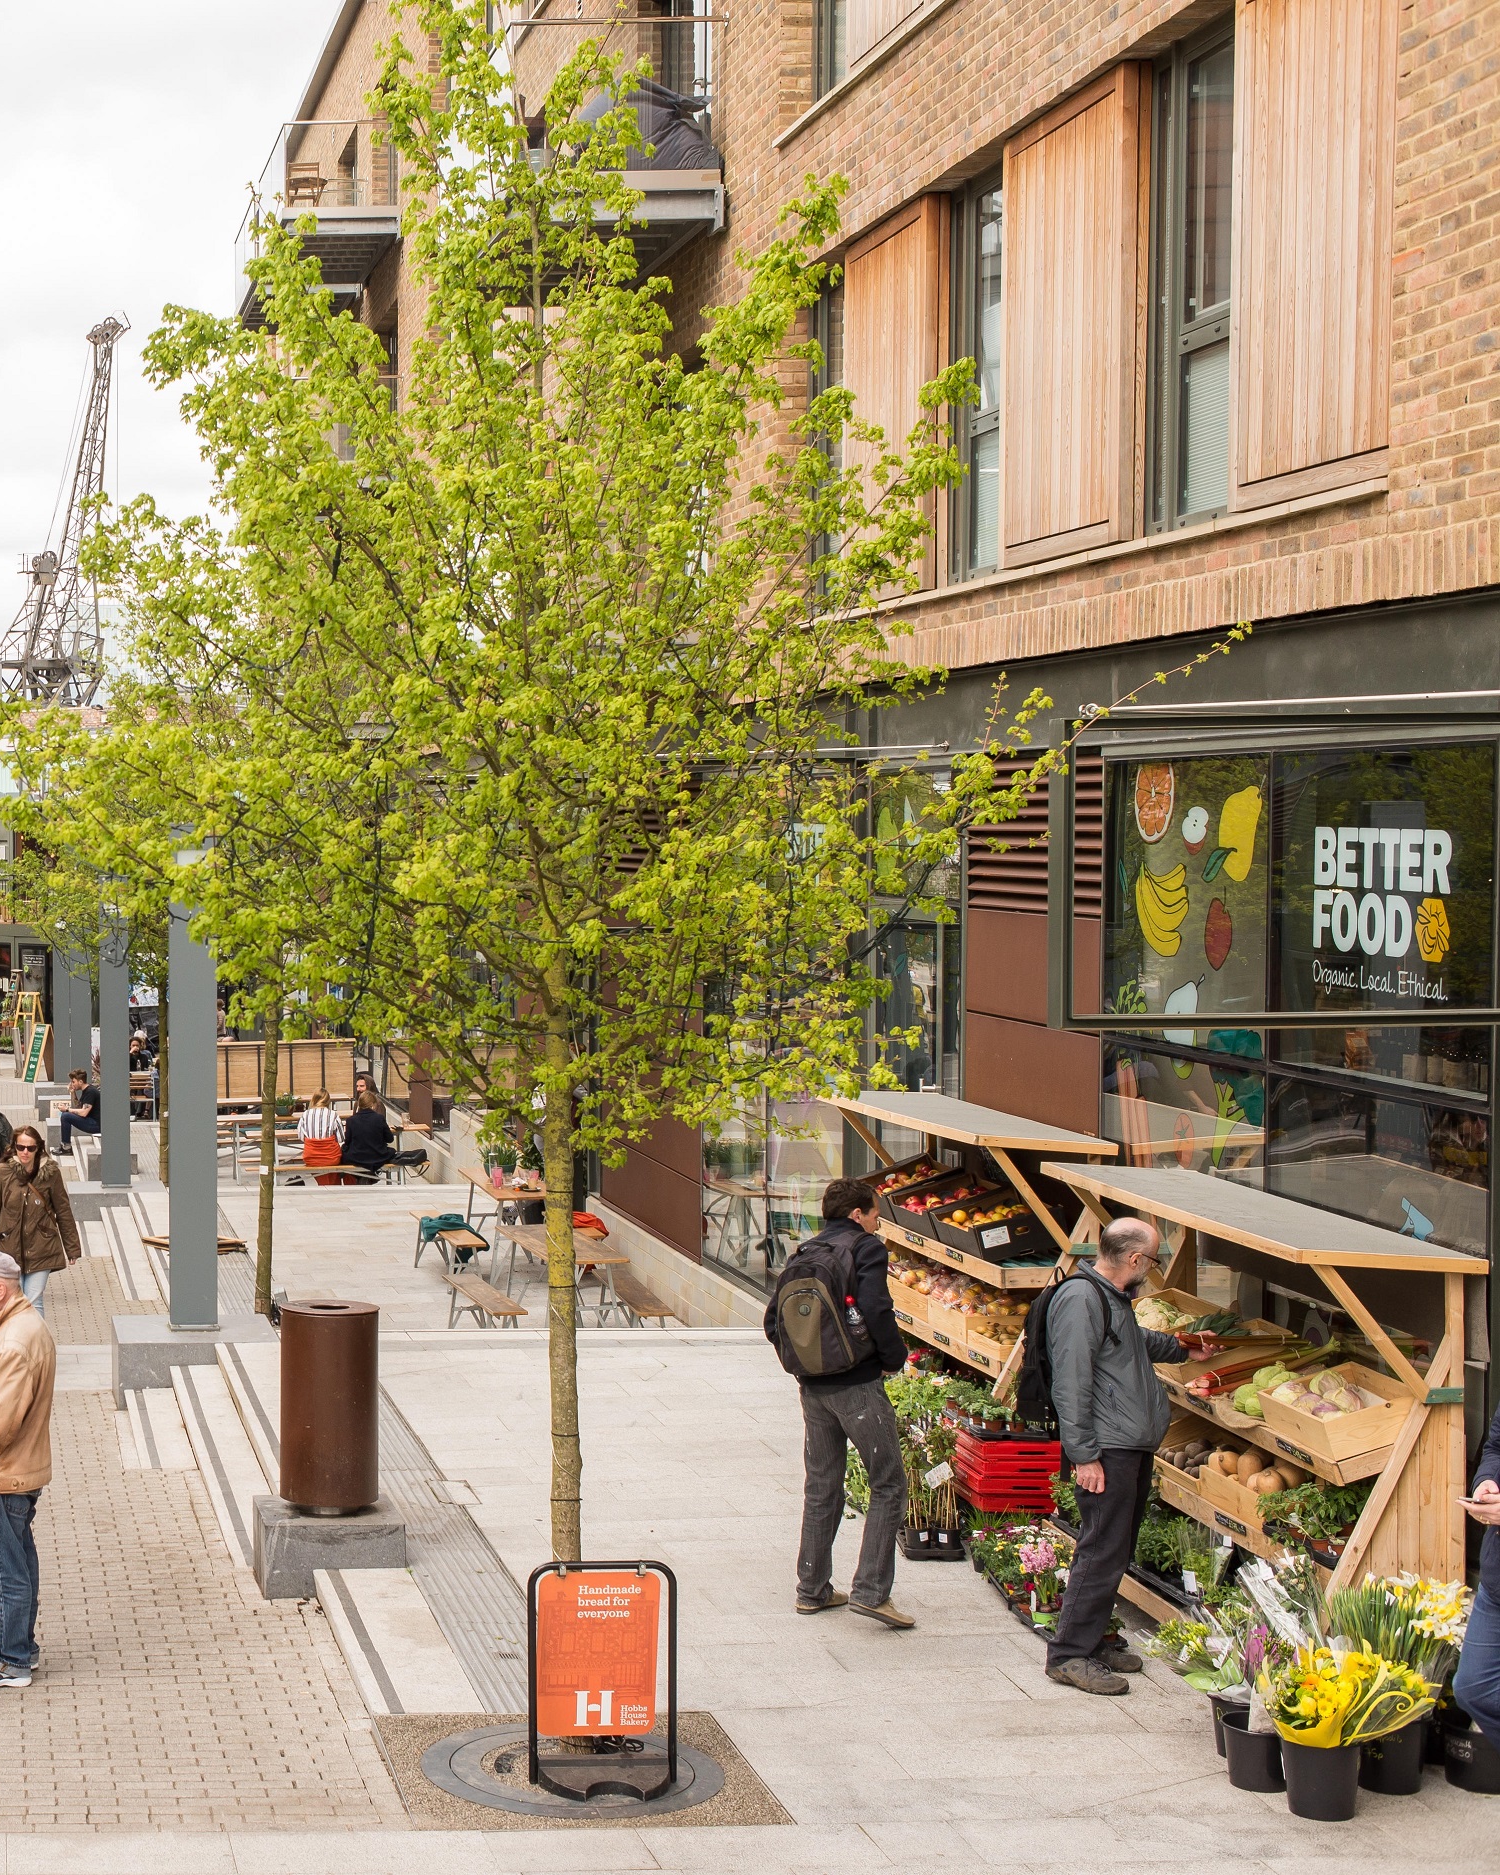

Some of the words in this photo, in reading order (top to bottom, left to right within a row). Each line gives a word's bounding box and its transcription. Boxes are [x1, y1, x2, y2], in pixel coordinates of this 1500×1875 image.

[1313, 826, 1453, 894] BETTER
[1312, 889, 1413, 958] FOOD
[1312, 959, 1358, 995] Organic.
[1360, 965, 1396, 994] Local.
[1398, 970, 1449, 1001] Ethical.
[578, 1584, 642, 1595] Handmade
[577, 1596, 611, 1606] bread
[612, 1596, 630, 1606] for
[577, 1610, 630, 1620] everyone
[573, 1690, 615, 1727] H
[620, 1704, 648, 1712] Hobbs
[620, 1711, 647, 1719] House
[620, 1718, 650, 1726] Bakery
